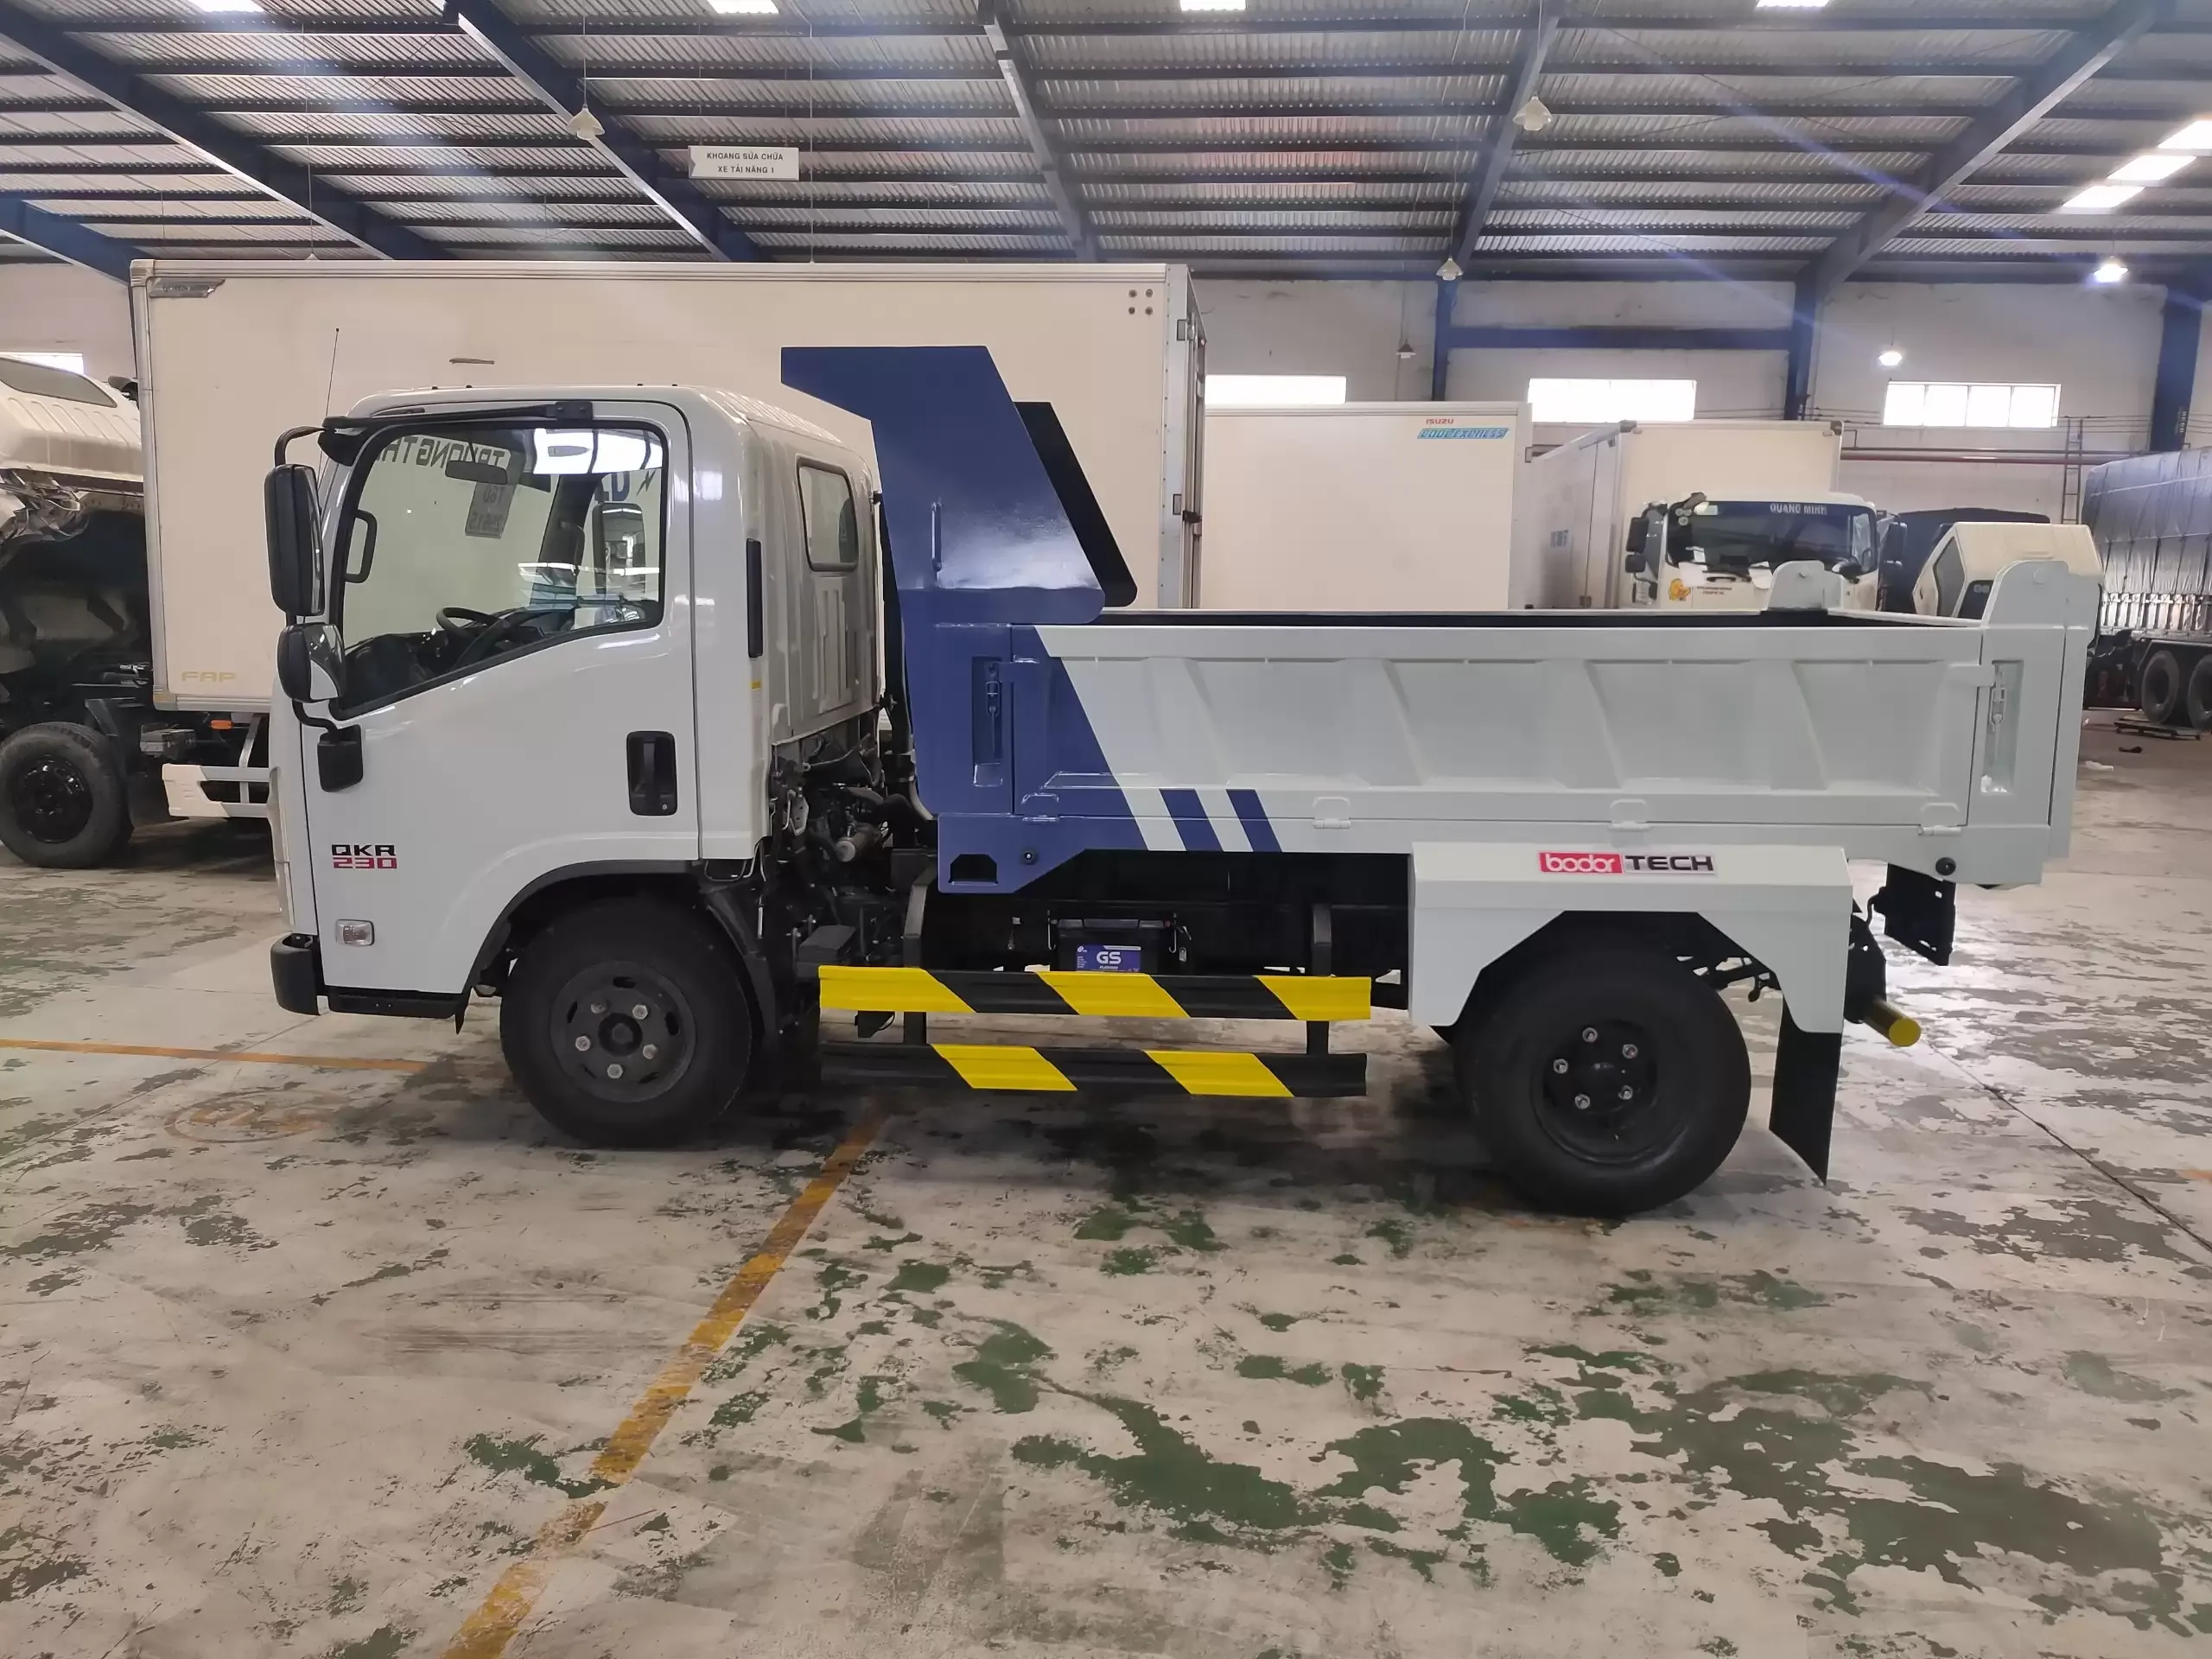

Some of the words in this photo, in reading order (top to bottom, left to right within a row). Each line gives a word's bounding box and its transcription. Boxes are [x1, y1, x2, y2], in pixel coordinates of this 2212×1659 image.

[181, 671, 236, 682] FAP
[332, 844, 396, 856] QKR
[333, 857, 397, 869] 230
[1624, 855, 1713, 871] TECH
[1096, 951, 1122, 964] GS
